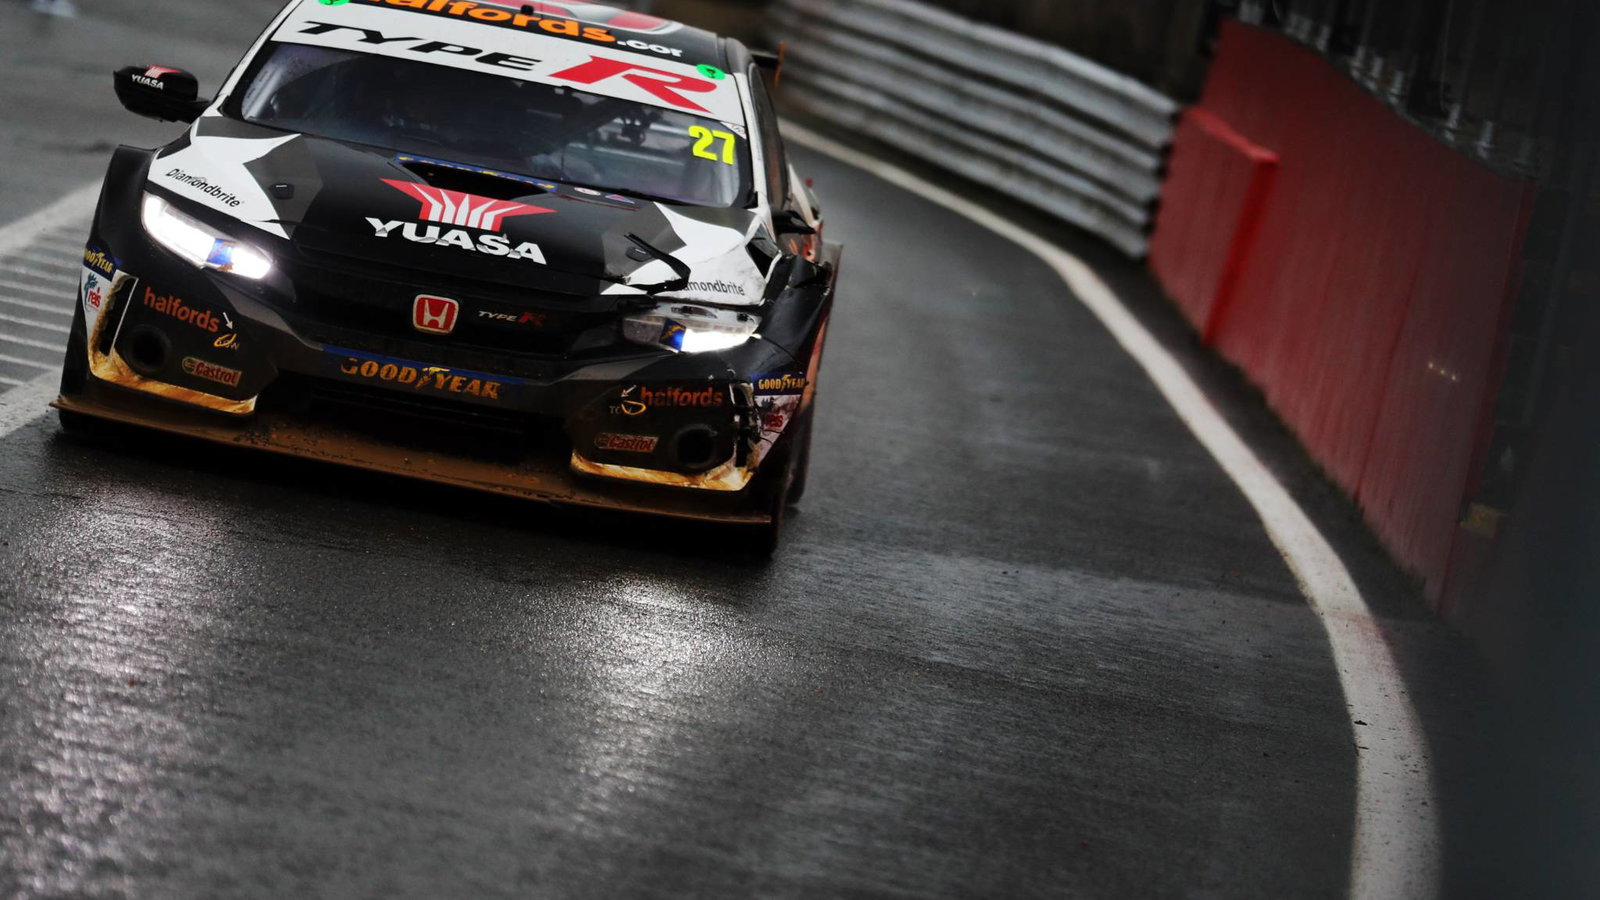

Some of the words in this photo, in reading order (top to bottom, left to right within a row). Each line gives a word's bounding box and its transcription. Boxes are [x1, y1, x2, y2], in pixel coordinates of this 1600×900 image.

[131, 74, 164, 90] YUASA
[298, 21, 542, 71] TYPE
[548, 55, 718, 114] R
[688, 125, 735, 165] 27
[165, 168, 240, 208] Diamondbrite
[365, 217, 547, 265] YUASA
[143, 286, 221, 332] halfords
[478, 310, 517, 322] TYPE
[195, 362, 239, 385] Castrol
[341, 357, 501, 399] GOODYEAR
[641, 386, 724, 407] halfords
[607, 434, 655, 450] Castrol
